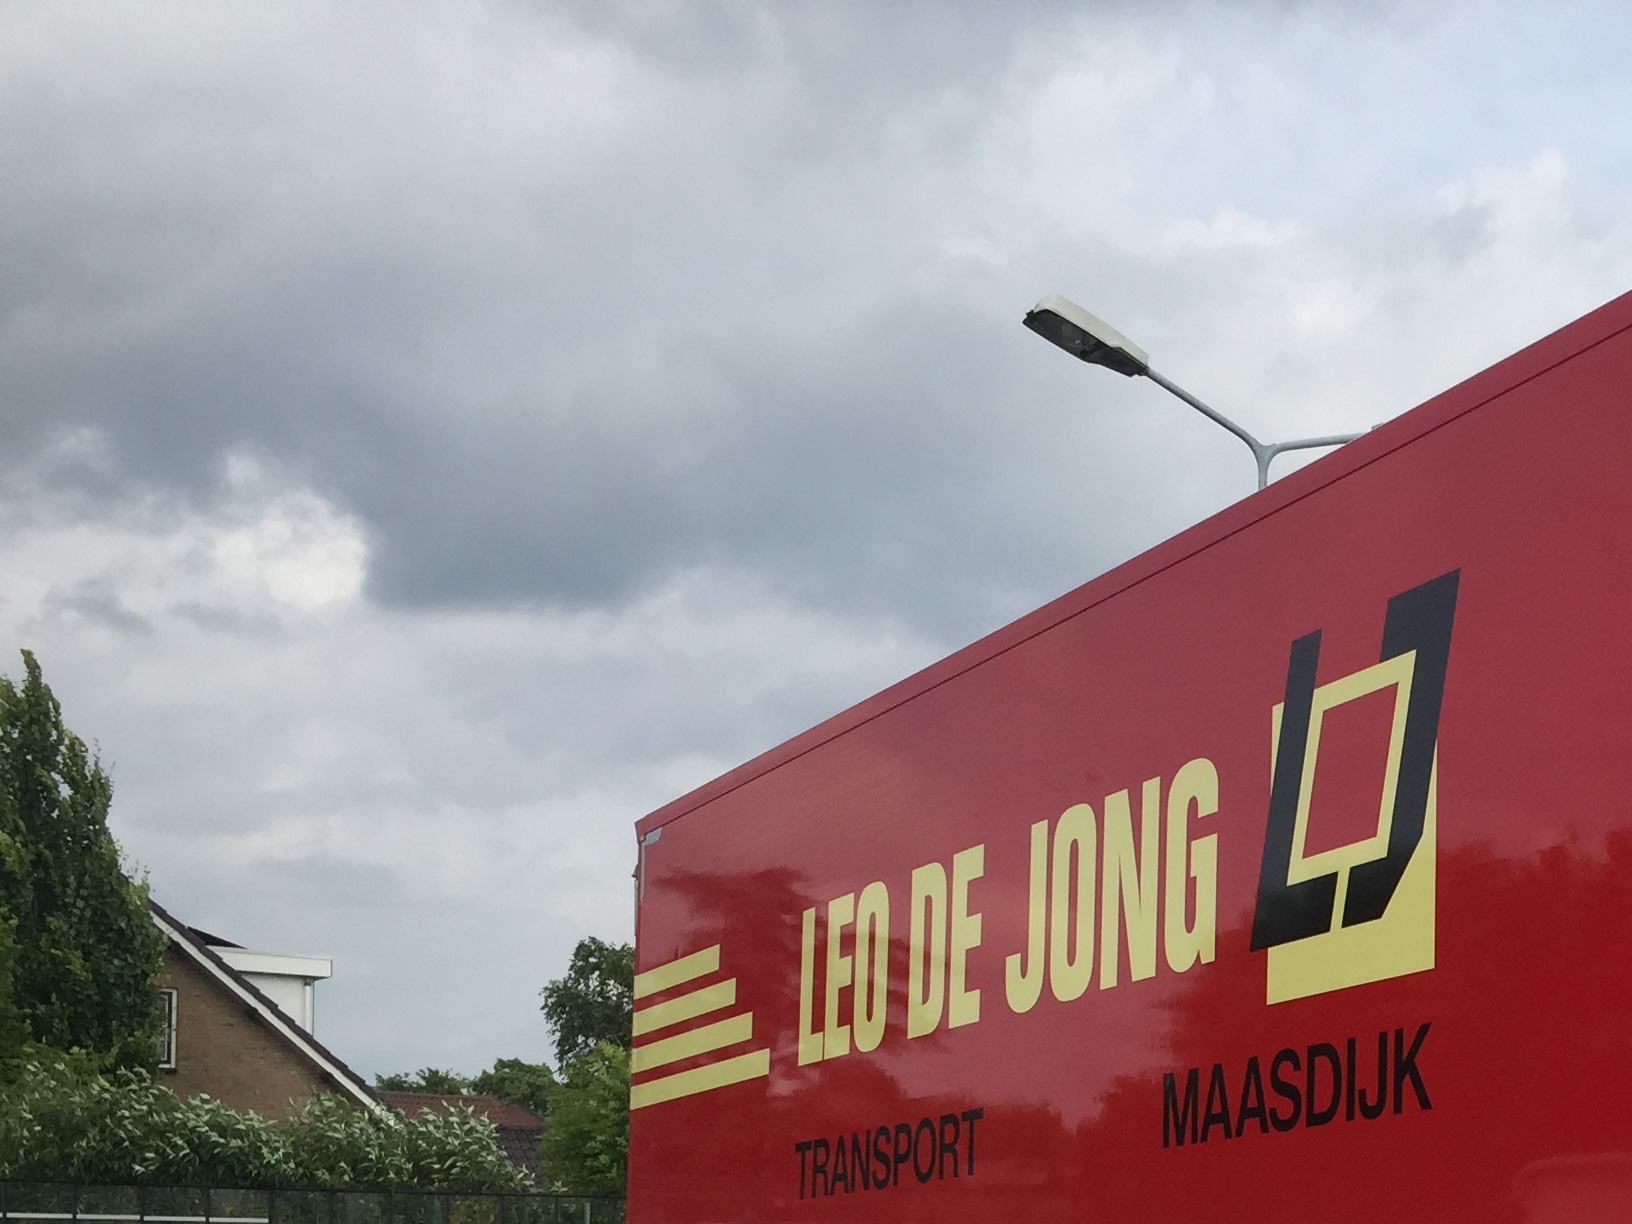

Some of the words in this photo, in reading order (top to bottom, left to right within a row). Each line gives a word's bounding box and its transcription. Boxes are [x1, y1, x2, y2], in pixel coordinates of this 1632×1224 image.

[798, 881, 889, 1066] LEO
[907, 844, 984, 1039] DE
[1005, 758, 1218, 1013] JONG
[1163, 1023, 1432, 1148] MAASDIJK
[796, 1108, 984, 1199] TRANSPORT
